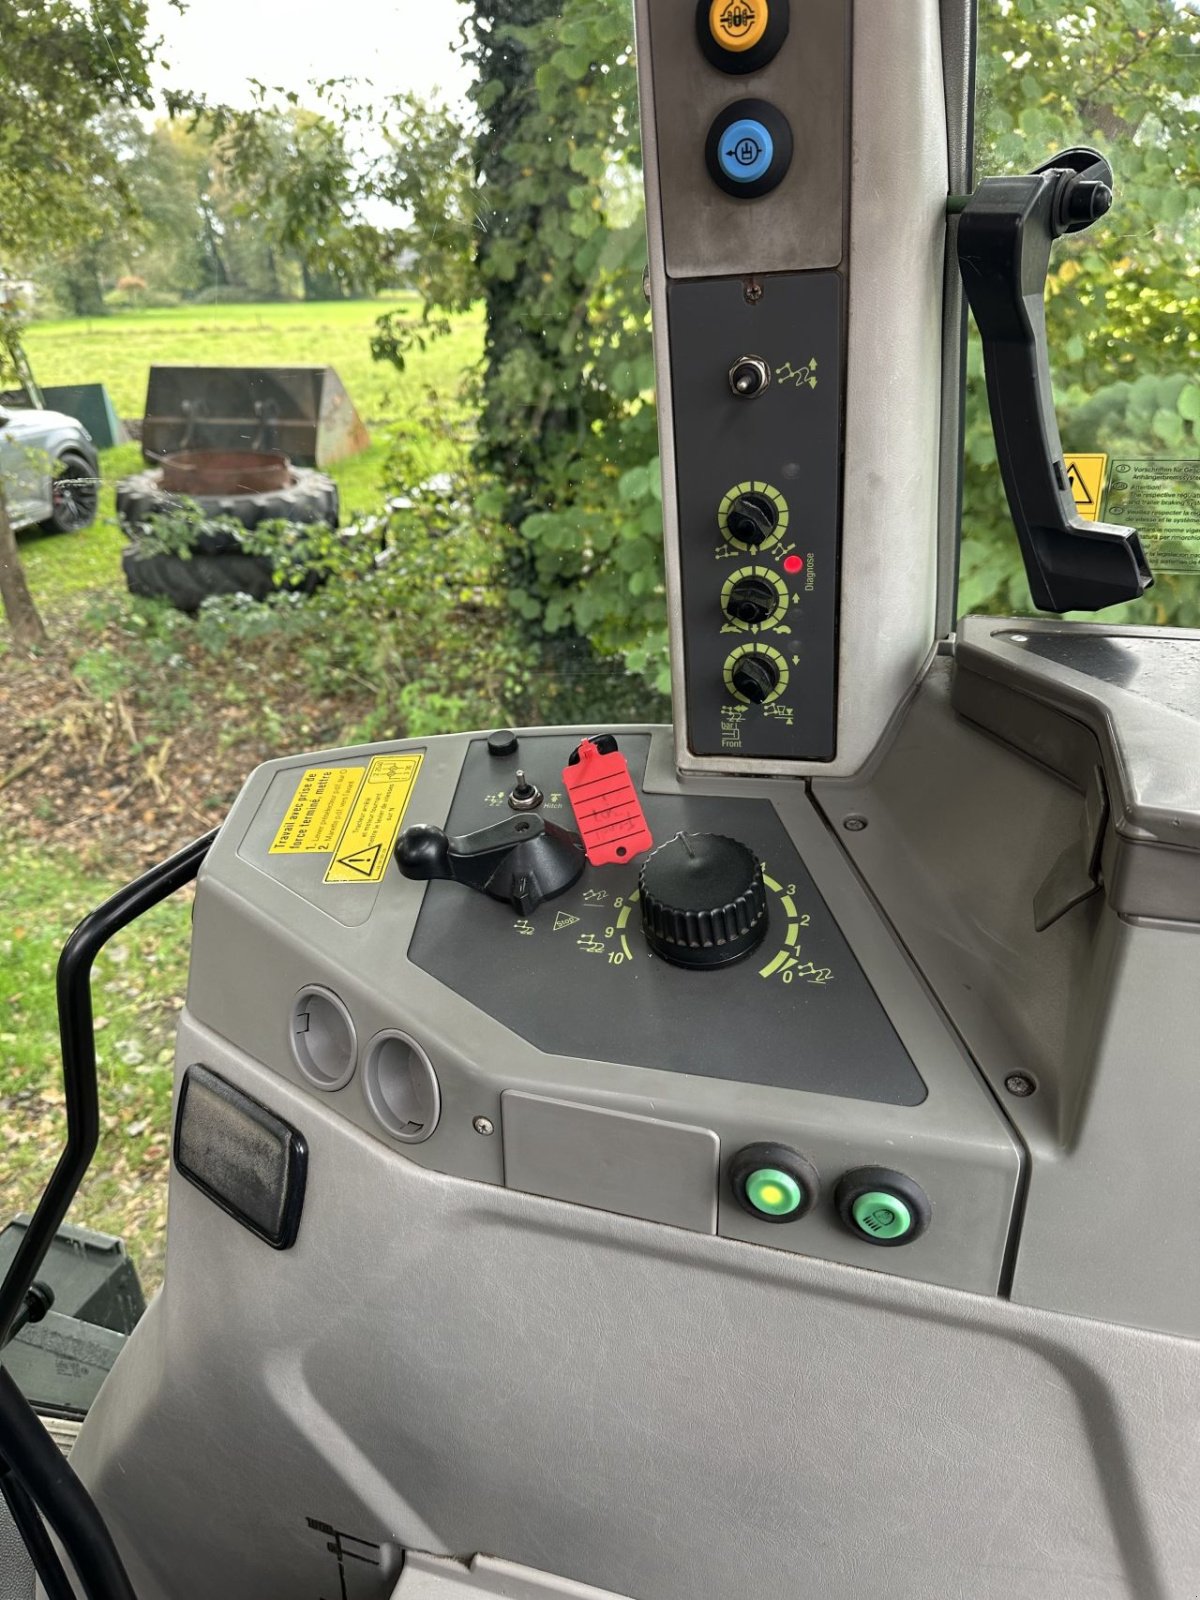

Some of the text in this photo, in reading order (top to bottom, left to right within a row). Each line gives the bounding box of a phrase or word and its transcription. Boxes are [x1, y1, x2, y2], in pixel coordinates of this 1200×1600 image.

[805, 552, 816, 591] Diagnose
[721, 721, 735, 730] bar
[721, 740, 743, 748] Front
[274, 773, 317, 848] Travail avec prise de
[289, 829, 307, 849] force
[316, 772, 332, 795] mettre
[786, 884, 796, 895] 3
[613, 897, 623, 908] 8
[556, 917, 575, 927] Stop
[800, 914, 811, 926] 2
[604, 926, 614, 938] 9
[794, 945, 801, 957] 1
[608, 951, 625, 965] 10
[782, 970, 793, 983] 0
